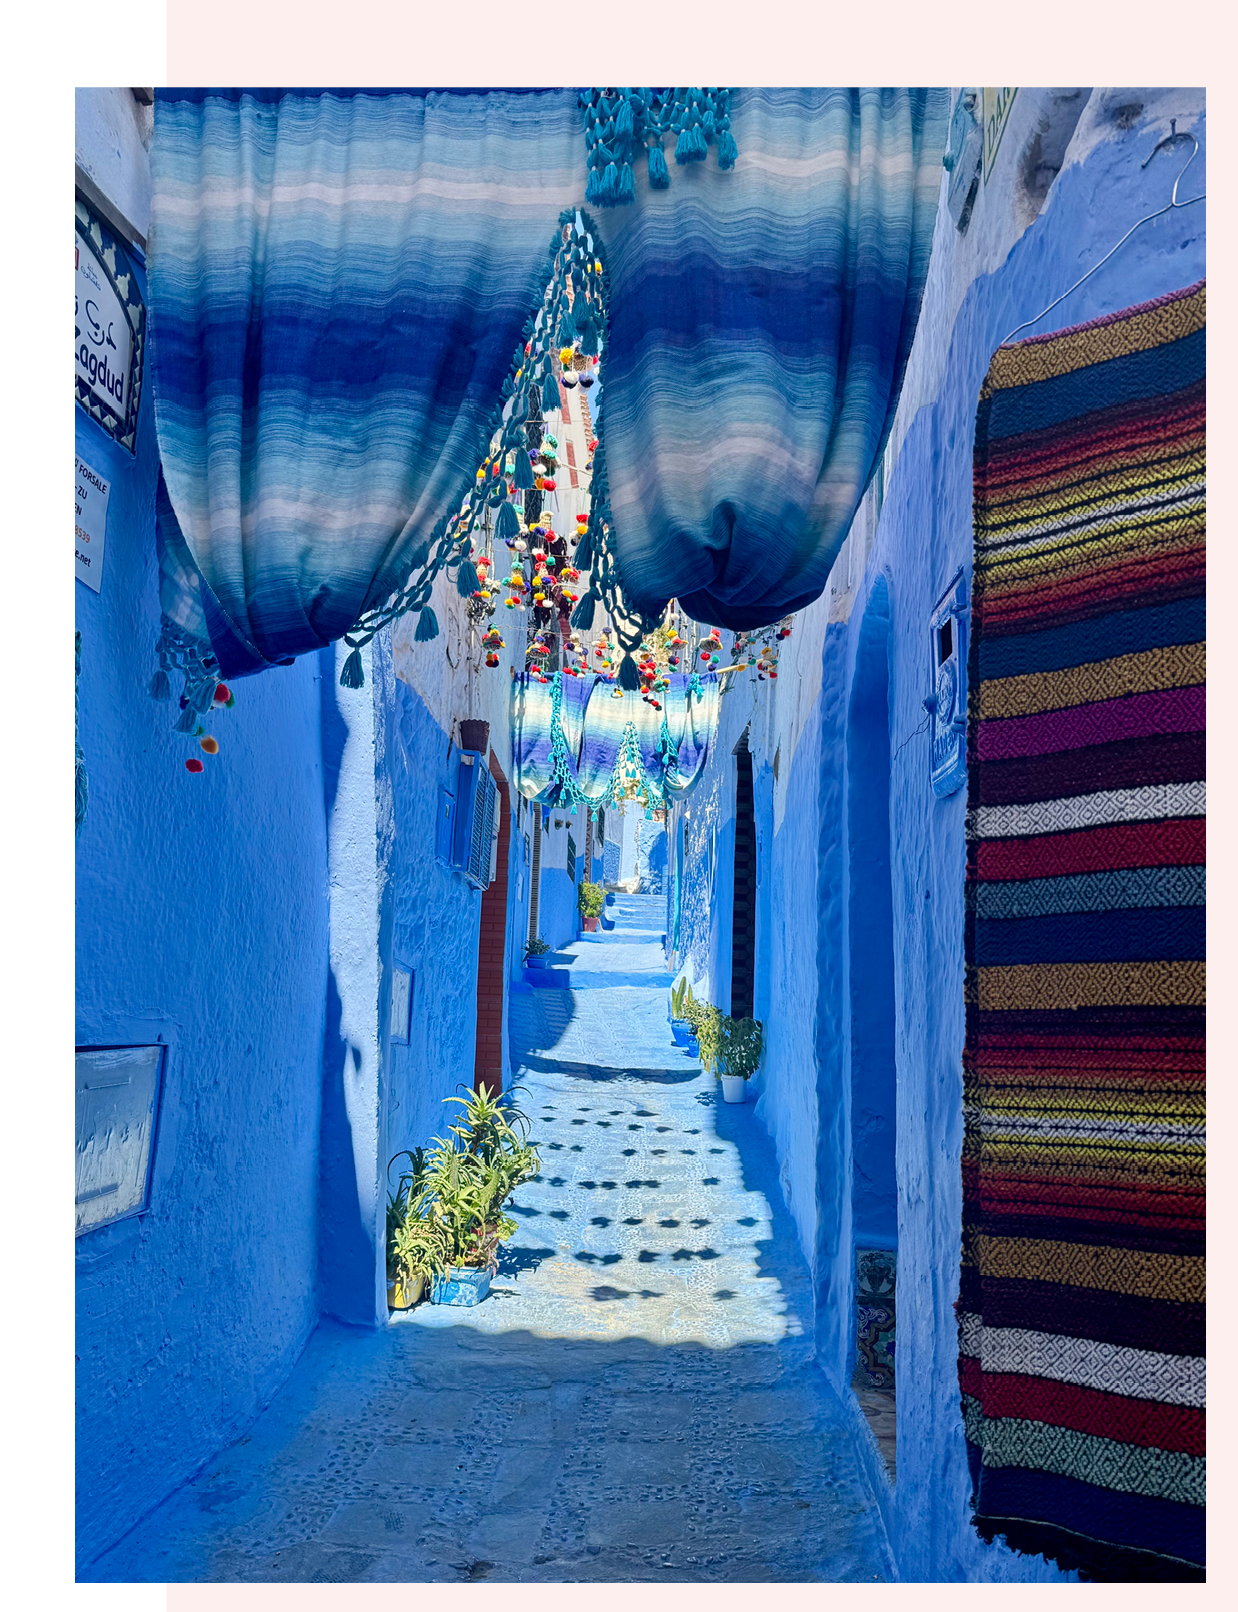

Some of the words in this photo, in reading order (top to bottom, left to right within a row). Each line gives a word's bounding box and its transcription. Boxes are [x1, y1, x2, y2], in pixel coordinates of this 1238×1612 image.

[79, 464, 108, 494] FORSALE
[77, 485, 88, 500] ZU
[75, 548, 92, 568] e.net
